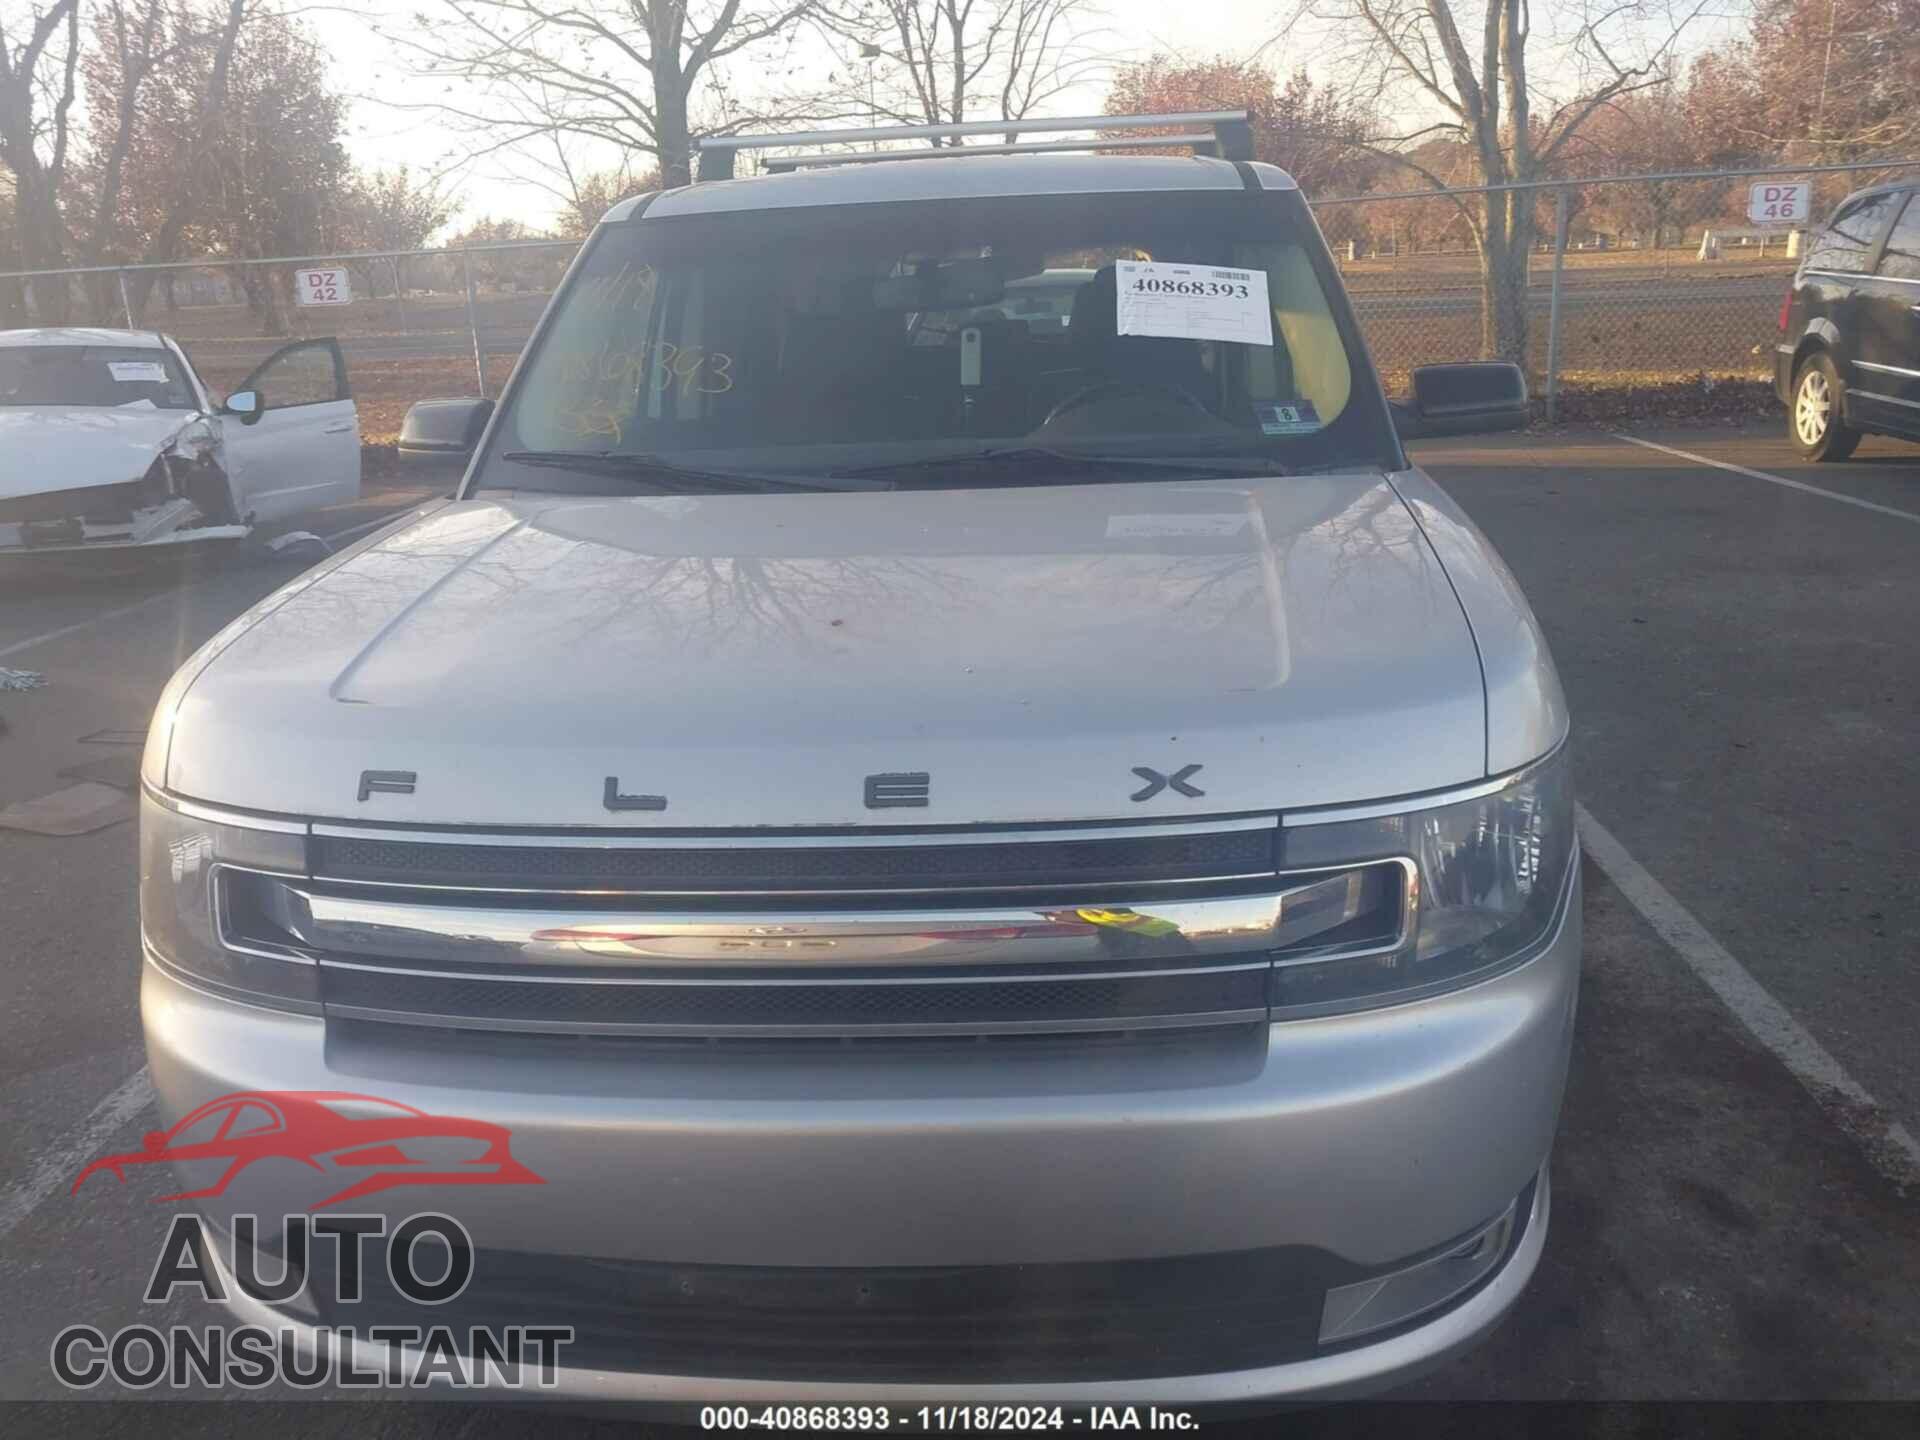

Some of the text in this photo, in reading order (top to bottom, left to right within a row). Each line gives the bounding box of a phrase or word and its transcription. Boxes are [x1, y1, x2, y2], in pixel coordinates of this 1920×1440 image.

[1764, 187, 1797, 202] DZ
[1764, 203, 1794, 217] 46
[309, 273, 337, 287] DZ
[313, 288, 337, 301] 42
[1132, 278, 1249, 299] 40868393
[357, 764, 1206, 812] FLEX
